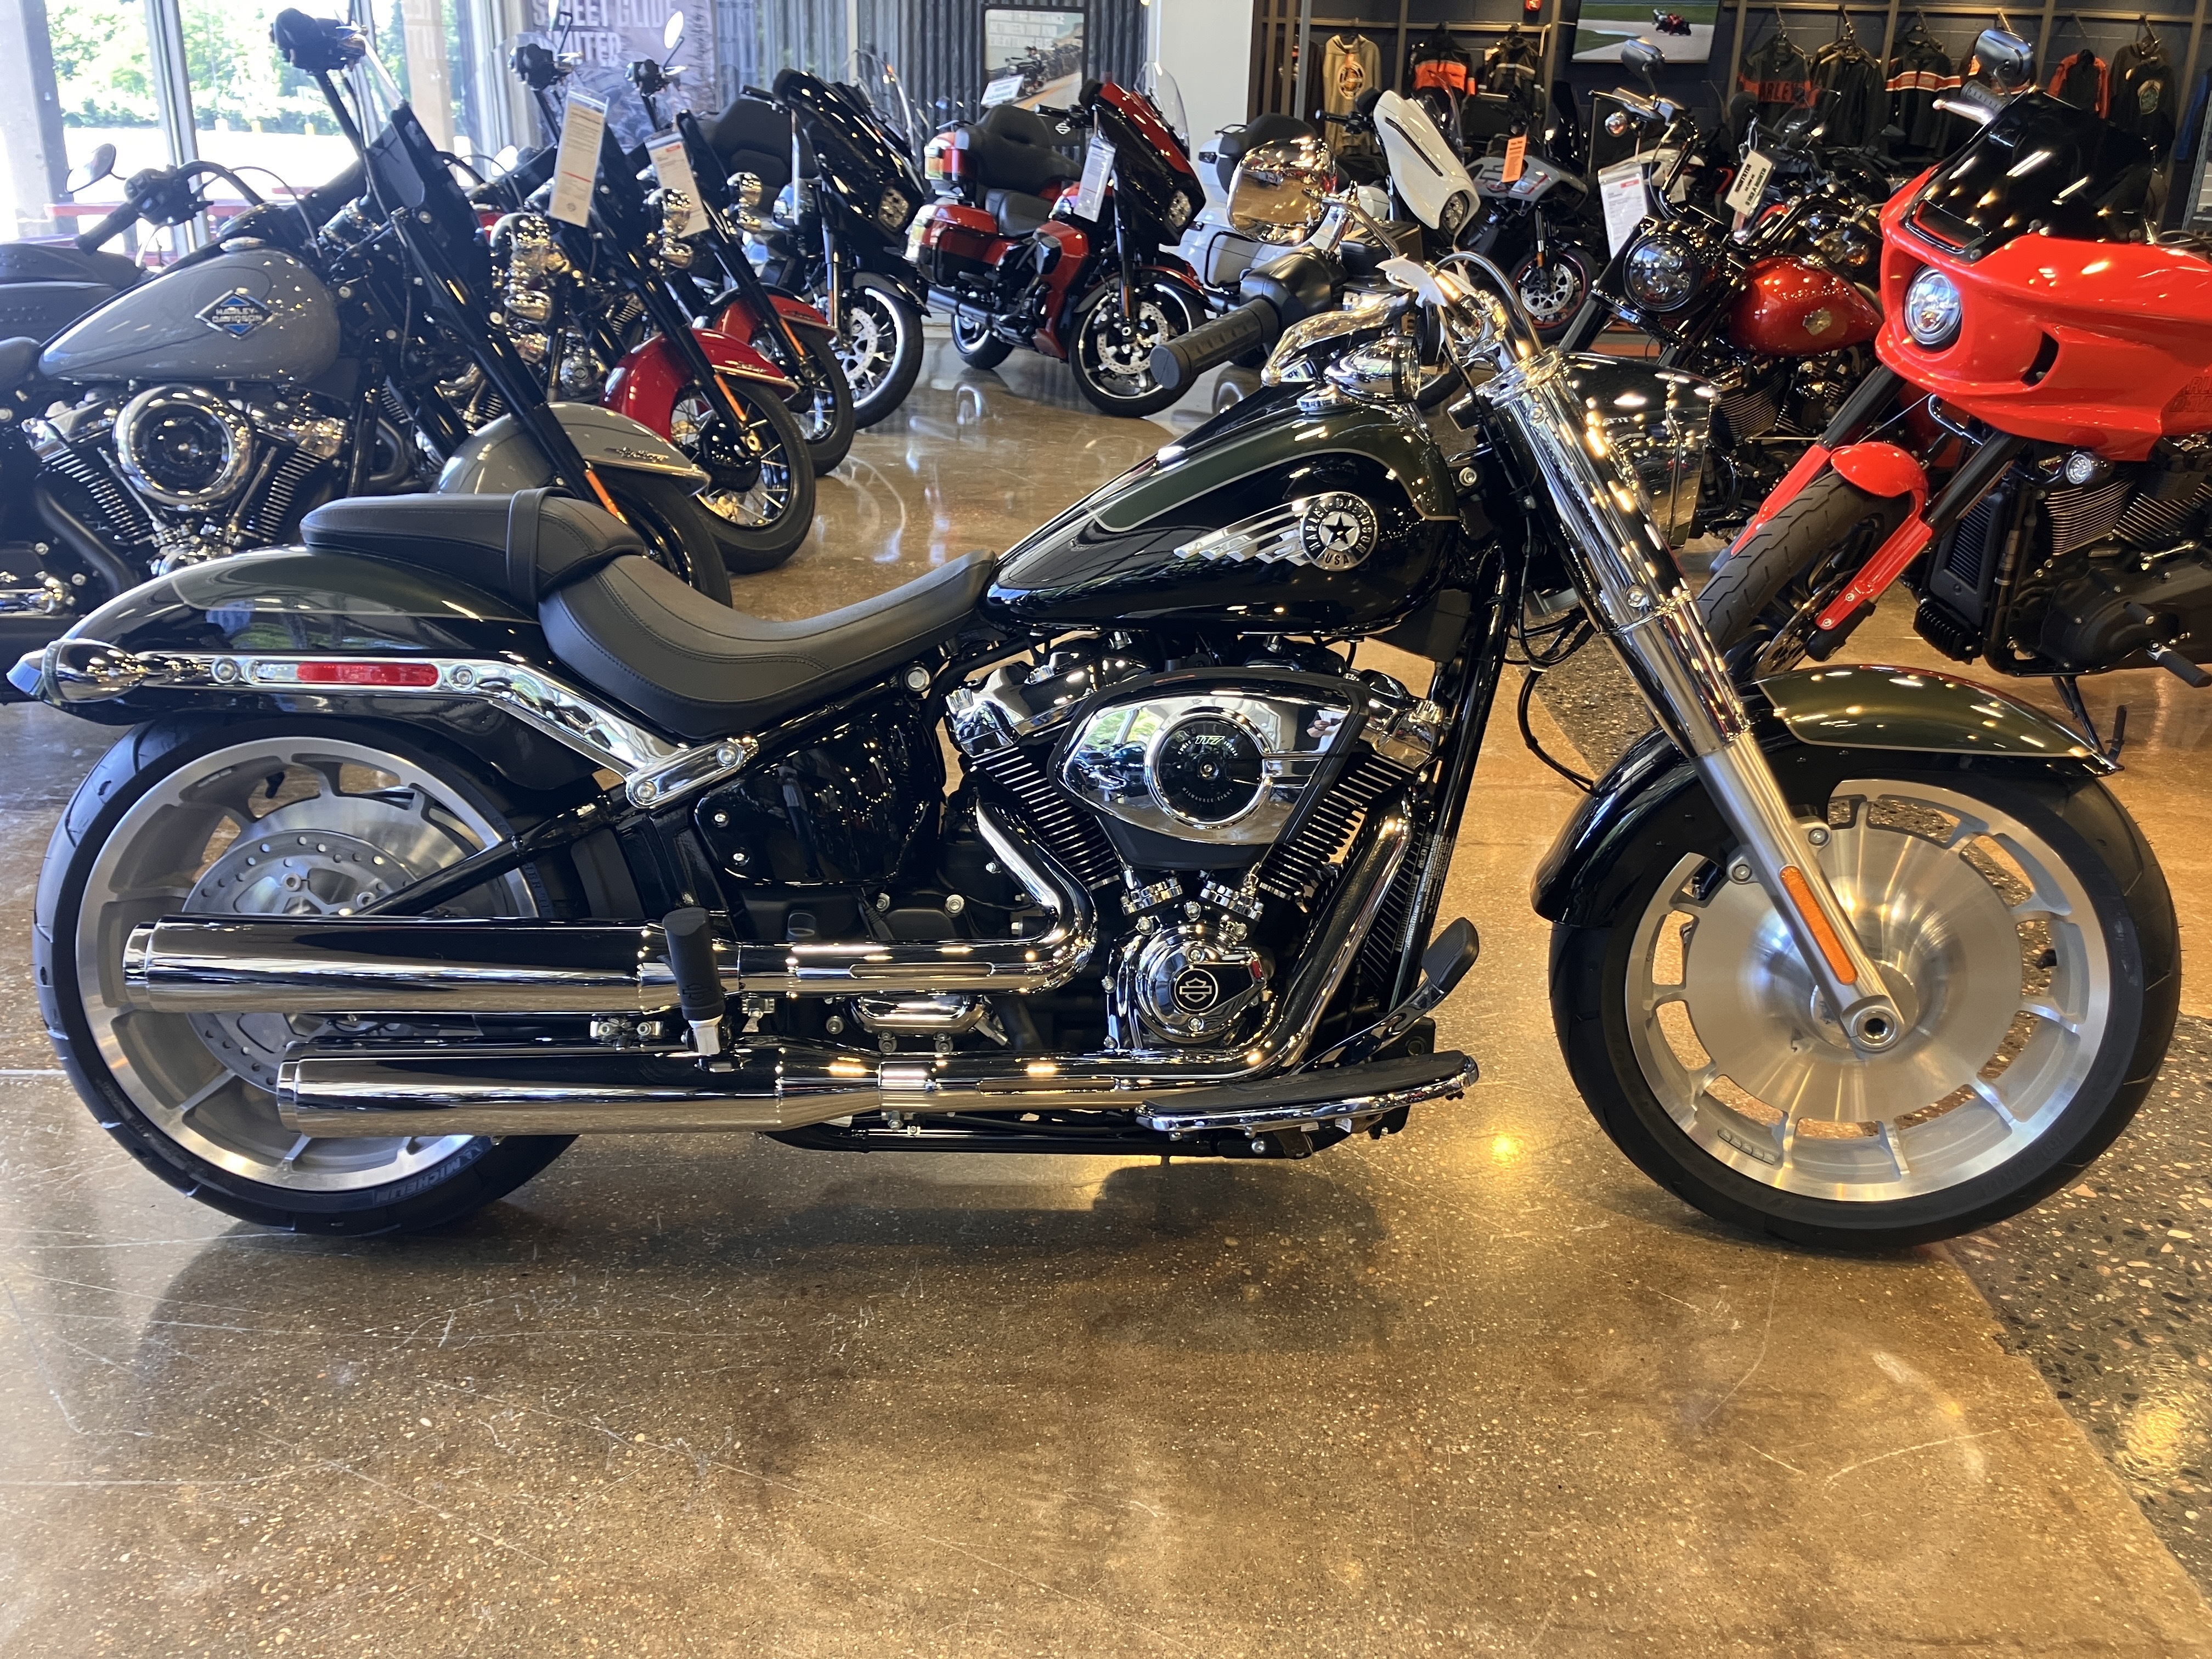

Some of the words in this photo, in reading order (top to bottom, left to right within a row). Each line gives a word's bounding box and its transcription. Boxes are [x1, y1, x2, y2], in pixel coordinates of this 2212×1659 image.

[532, 0, 610, 26] SREET
[544, 31, 622, 67] MITED
[1324, 552, 1350, 565] USA
[1195, 735, 1226, 745] 117
[375, 1158, 461, 1203] MICHELIN
